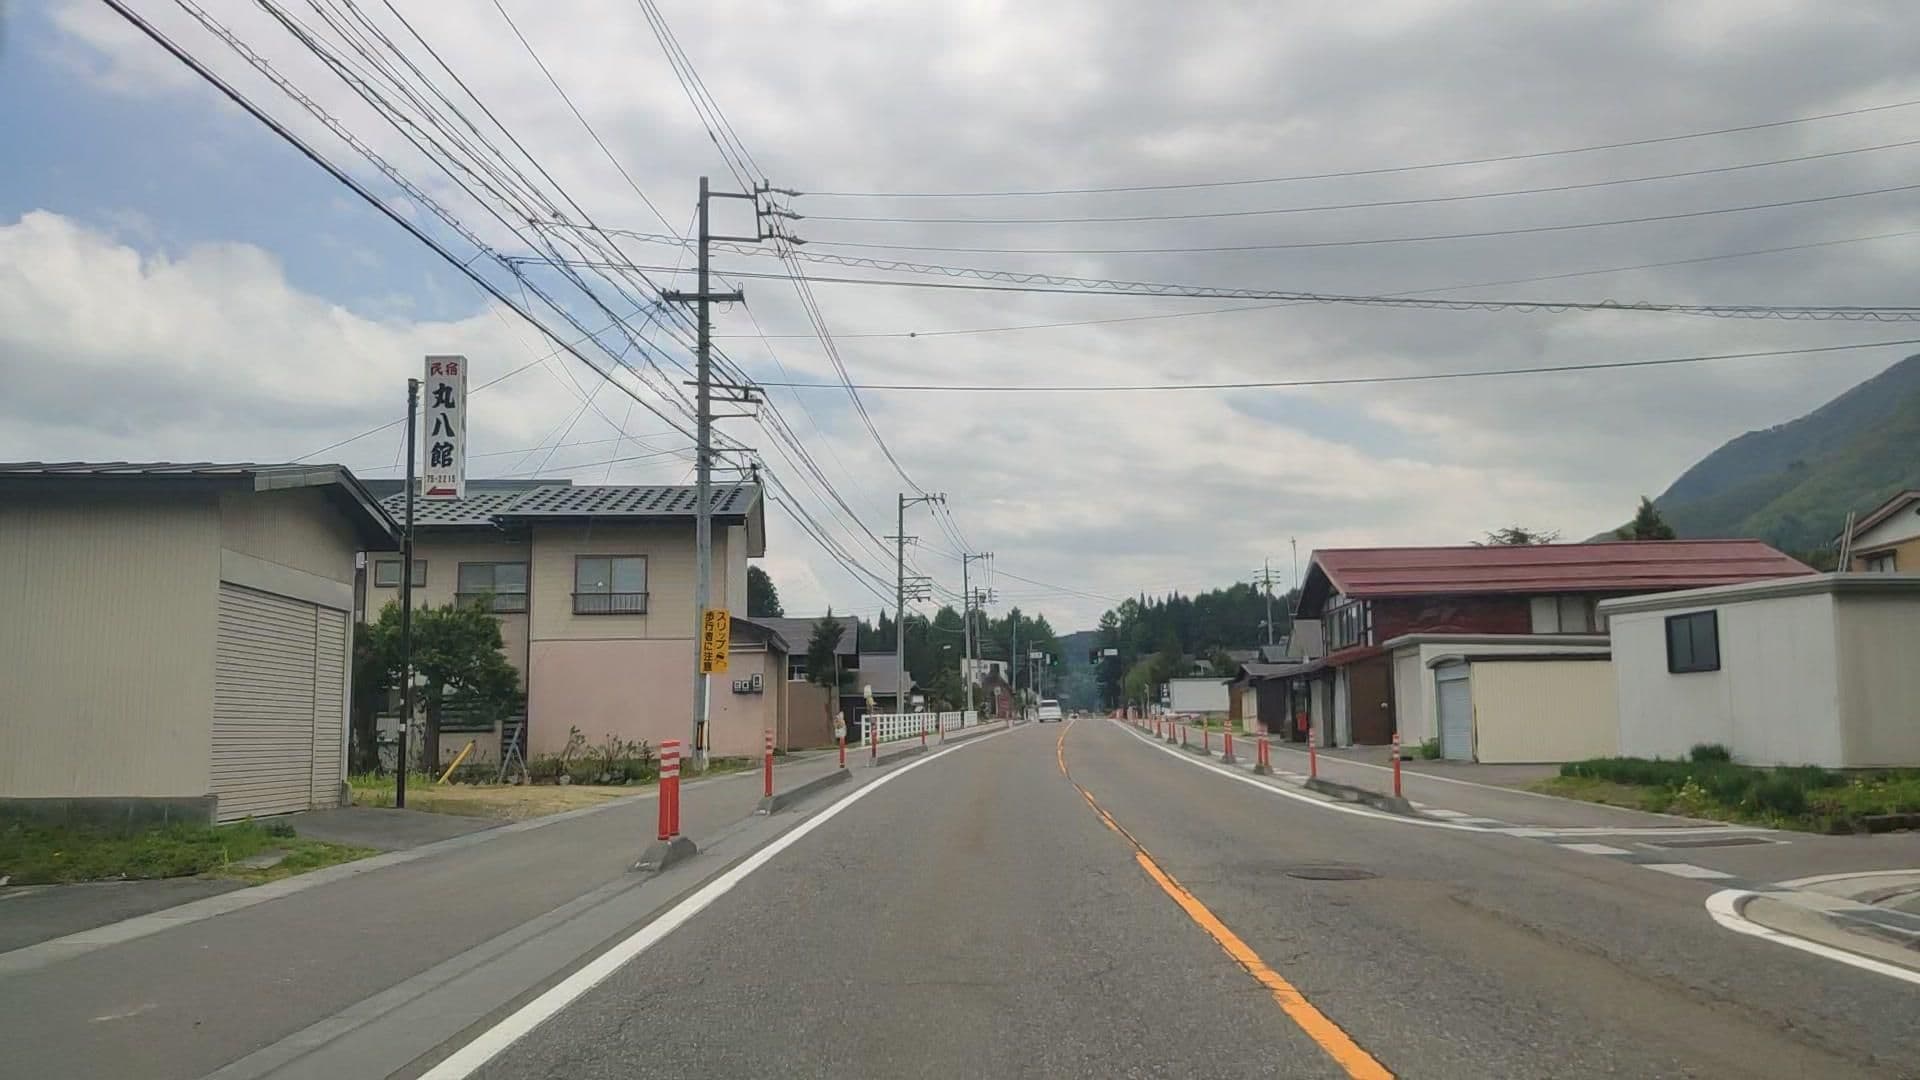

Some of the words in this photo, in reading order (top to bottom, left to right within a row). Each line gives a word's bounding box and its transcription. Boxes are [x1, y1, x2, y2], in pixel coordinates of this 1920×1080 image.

[430, 362, 458, 376] 民宿
[431, 382, 455, 467] 丸八館
[703, 612, 714, 671] 歩行者に注意
[716, 612, 727, 649] スリップ
